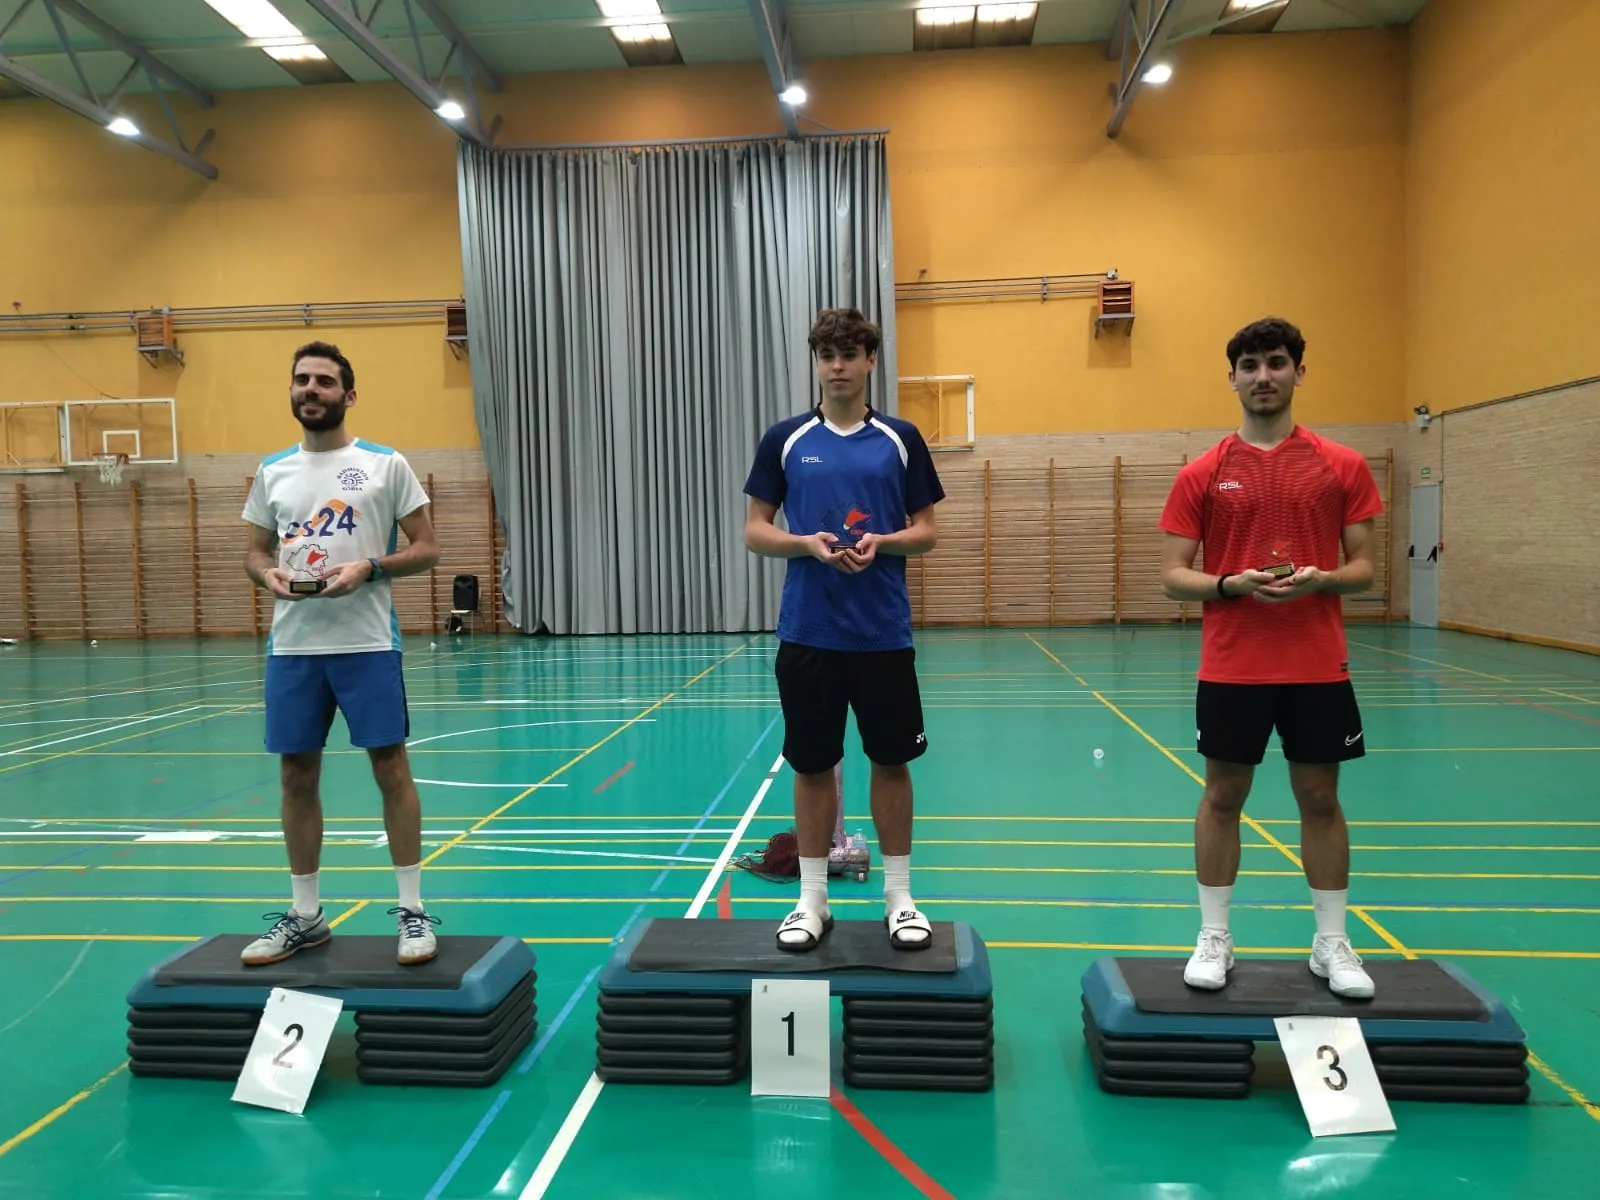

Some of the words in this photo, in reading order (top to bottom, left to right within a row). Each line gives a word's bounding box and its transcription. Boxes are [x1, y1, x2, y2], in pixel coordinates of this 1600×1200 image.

[801, 456, 823, 464] RSL
[1219, 480, 1243, 491] RSL
[272, 1023, 304, 1069] 2
[781, 1011, 795, 1056] 1
[1316, 1044, 1348, 1091] 3
